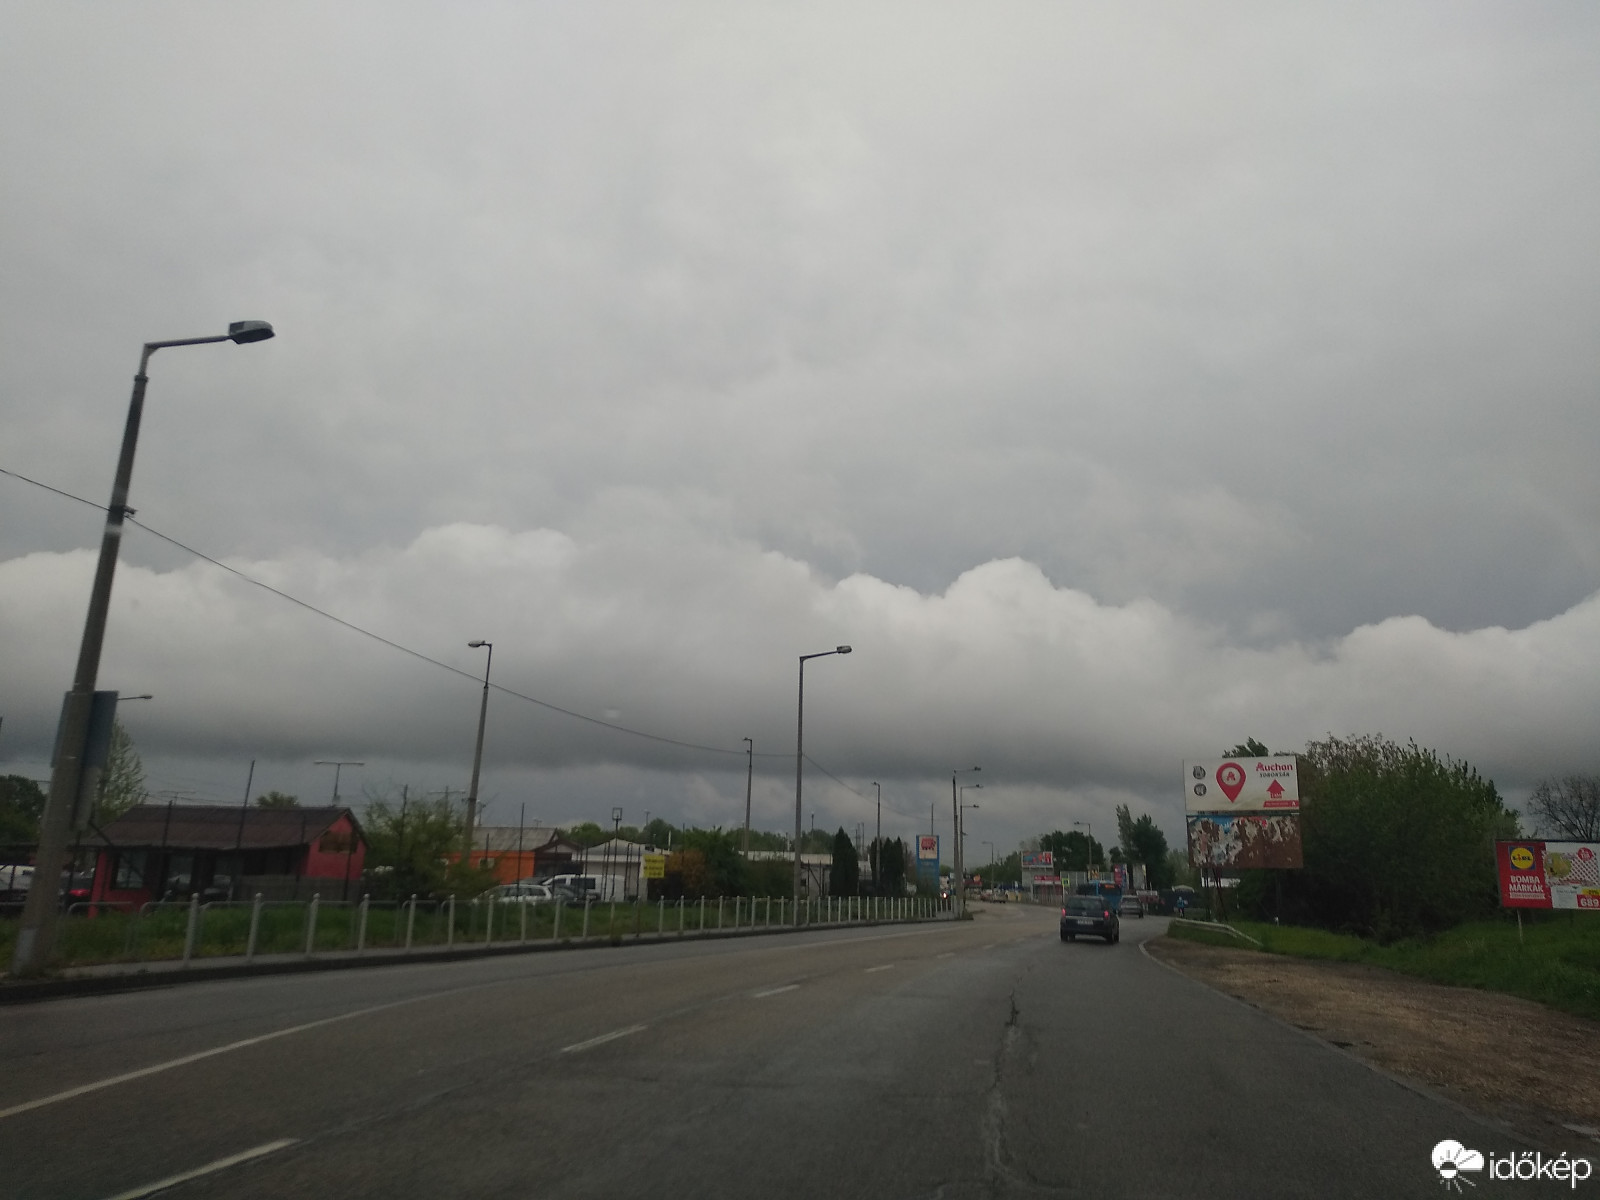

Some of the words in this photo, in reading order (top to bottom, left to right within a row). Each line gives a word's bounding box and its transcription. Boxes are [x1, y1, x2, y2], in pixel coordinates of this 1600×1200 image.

[1256, 762, 1293, 771] Auchan
[1510, 875, 1540, 883] BOMBA
[1509, 883, 1543, 893] MÁRKÁK
[1580, 897, 1599, 907] 689
